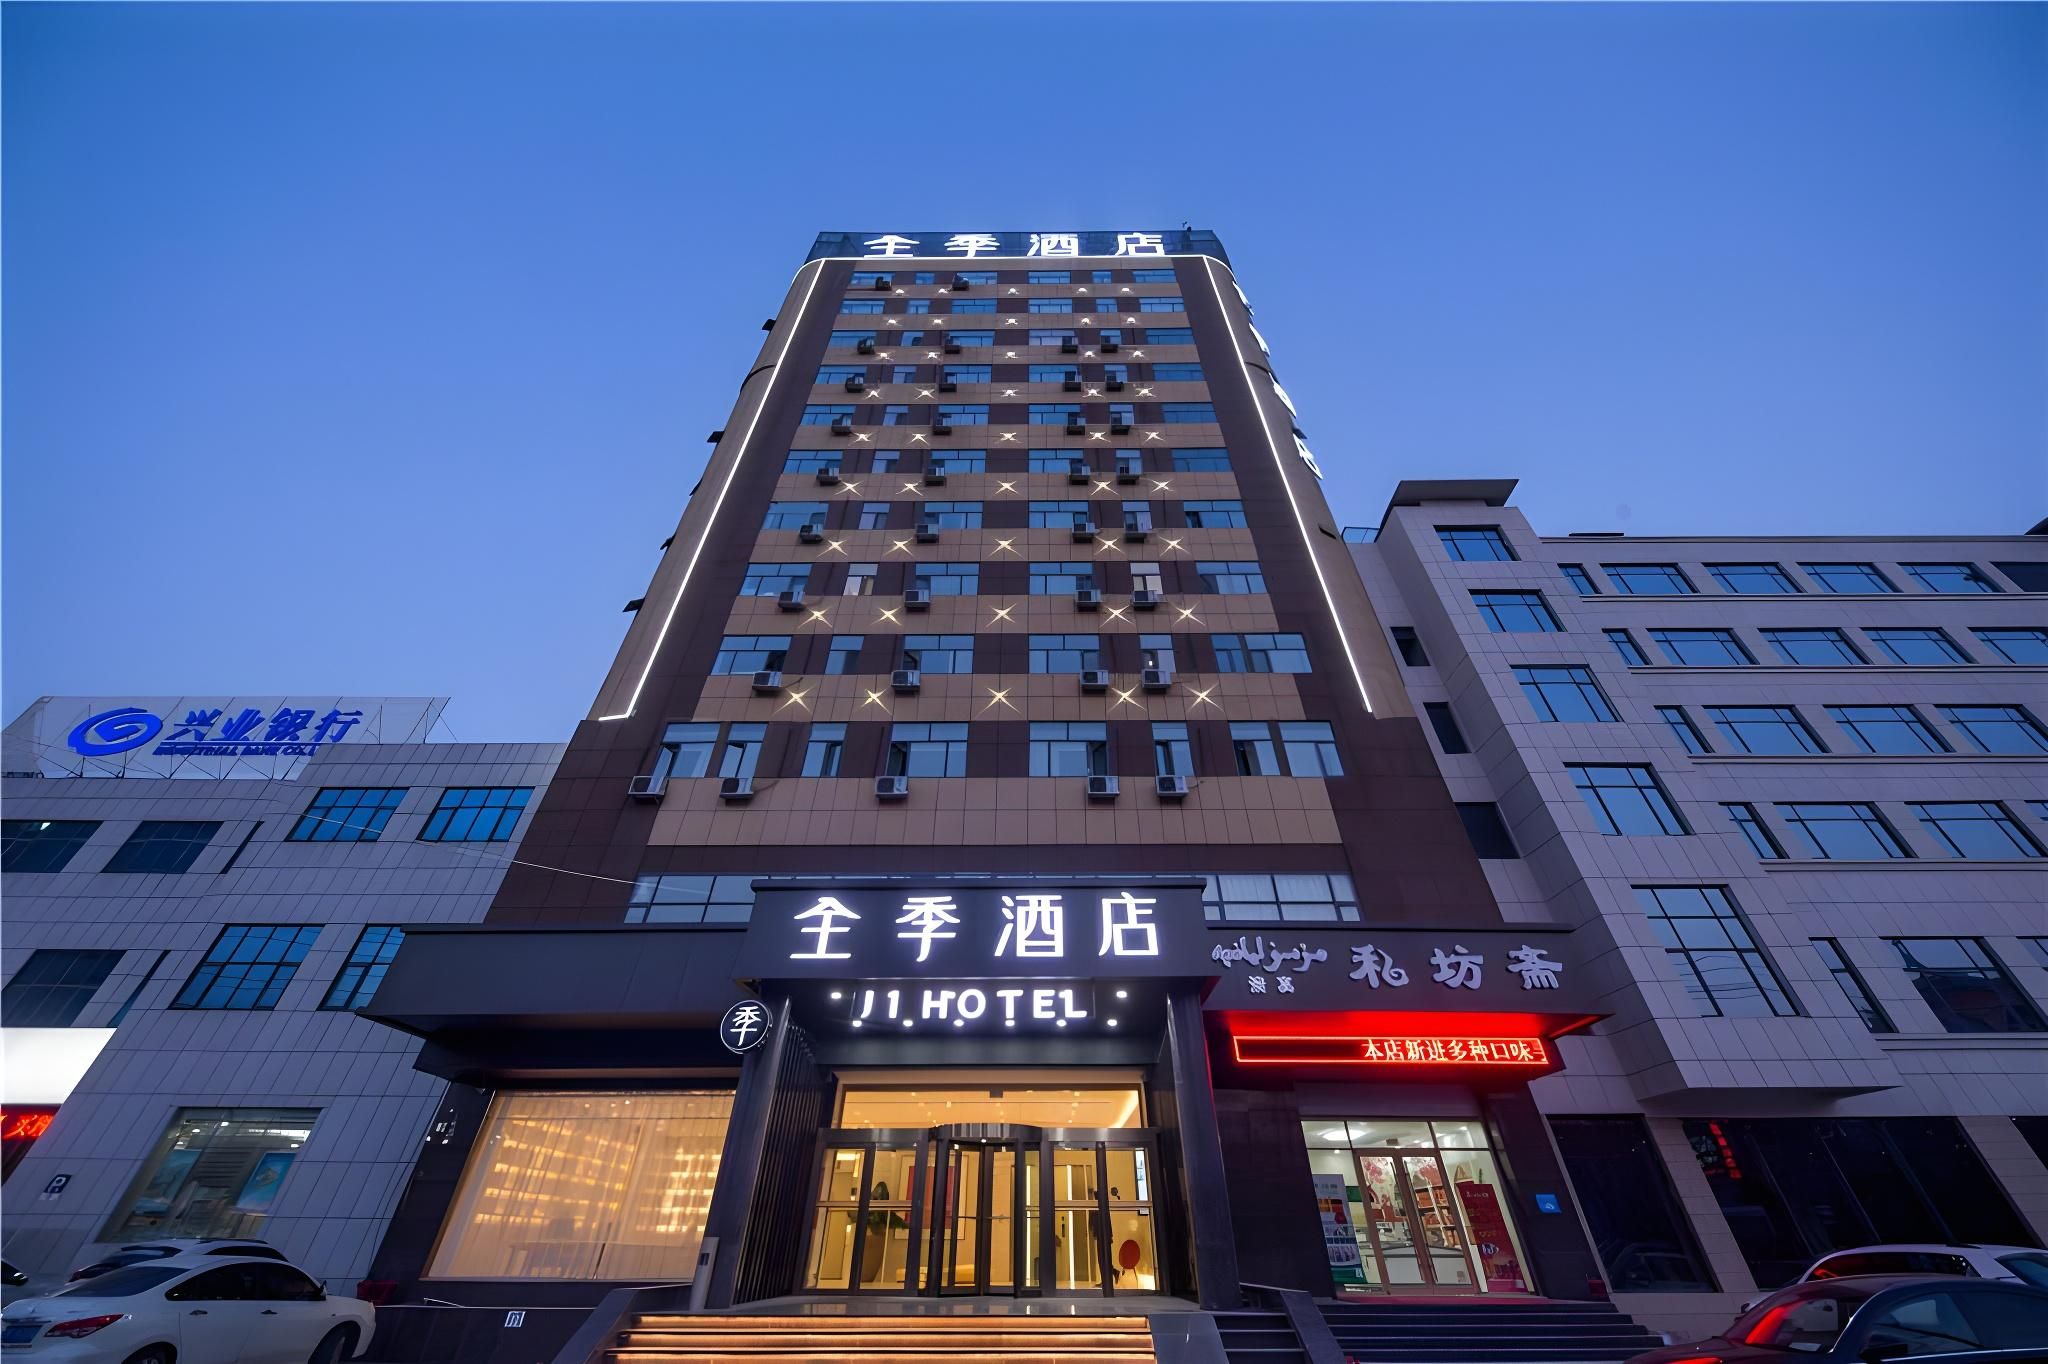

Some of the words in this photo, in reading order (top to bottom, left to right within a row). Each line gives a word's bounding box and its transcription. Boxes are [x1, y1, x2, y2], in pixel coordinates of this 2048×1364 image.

[863, 232, 1166, 257] 全季酒店
[160, 707, 364, 743] 兴业银行
[789, 891, 1160, 963] 全季酒店
[922, 988, 1088, 1019] HOTEL
[729, 1005, 762, 1047] 季
